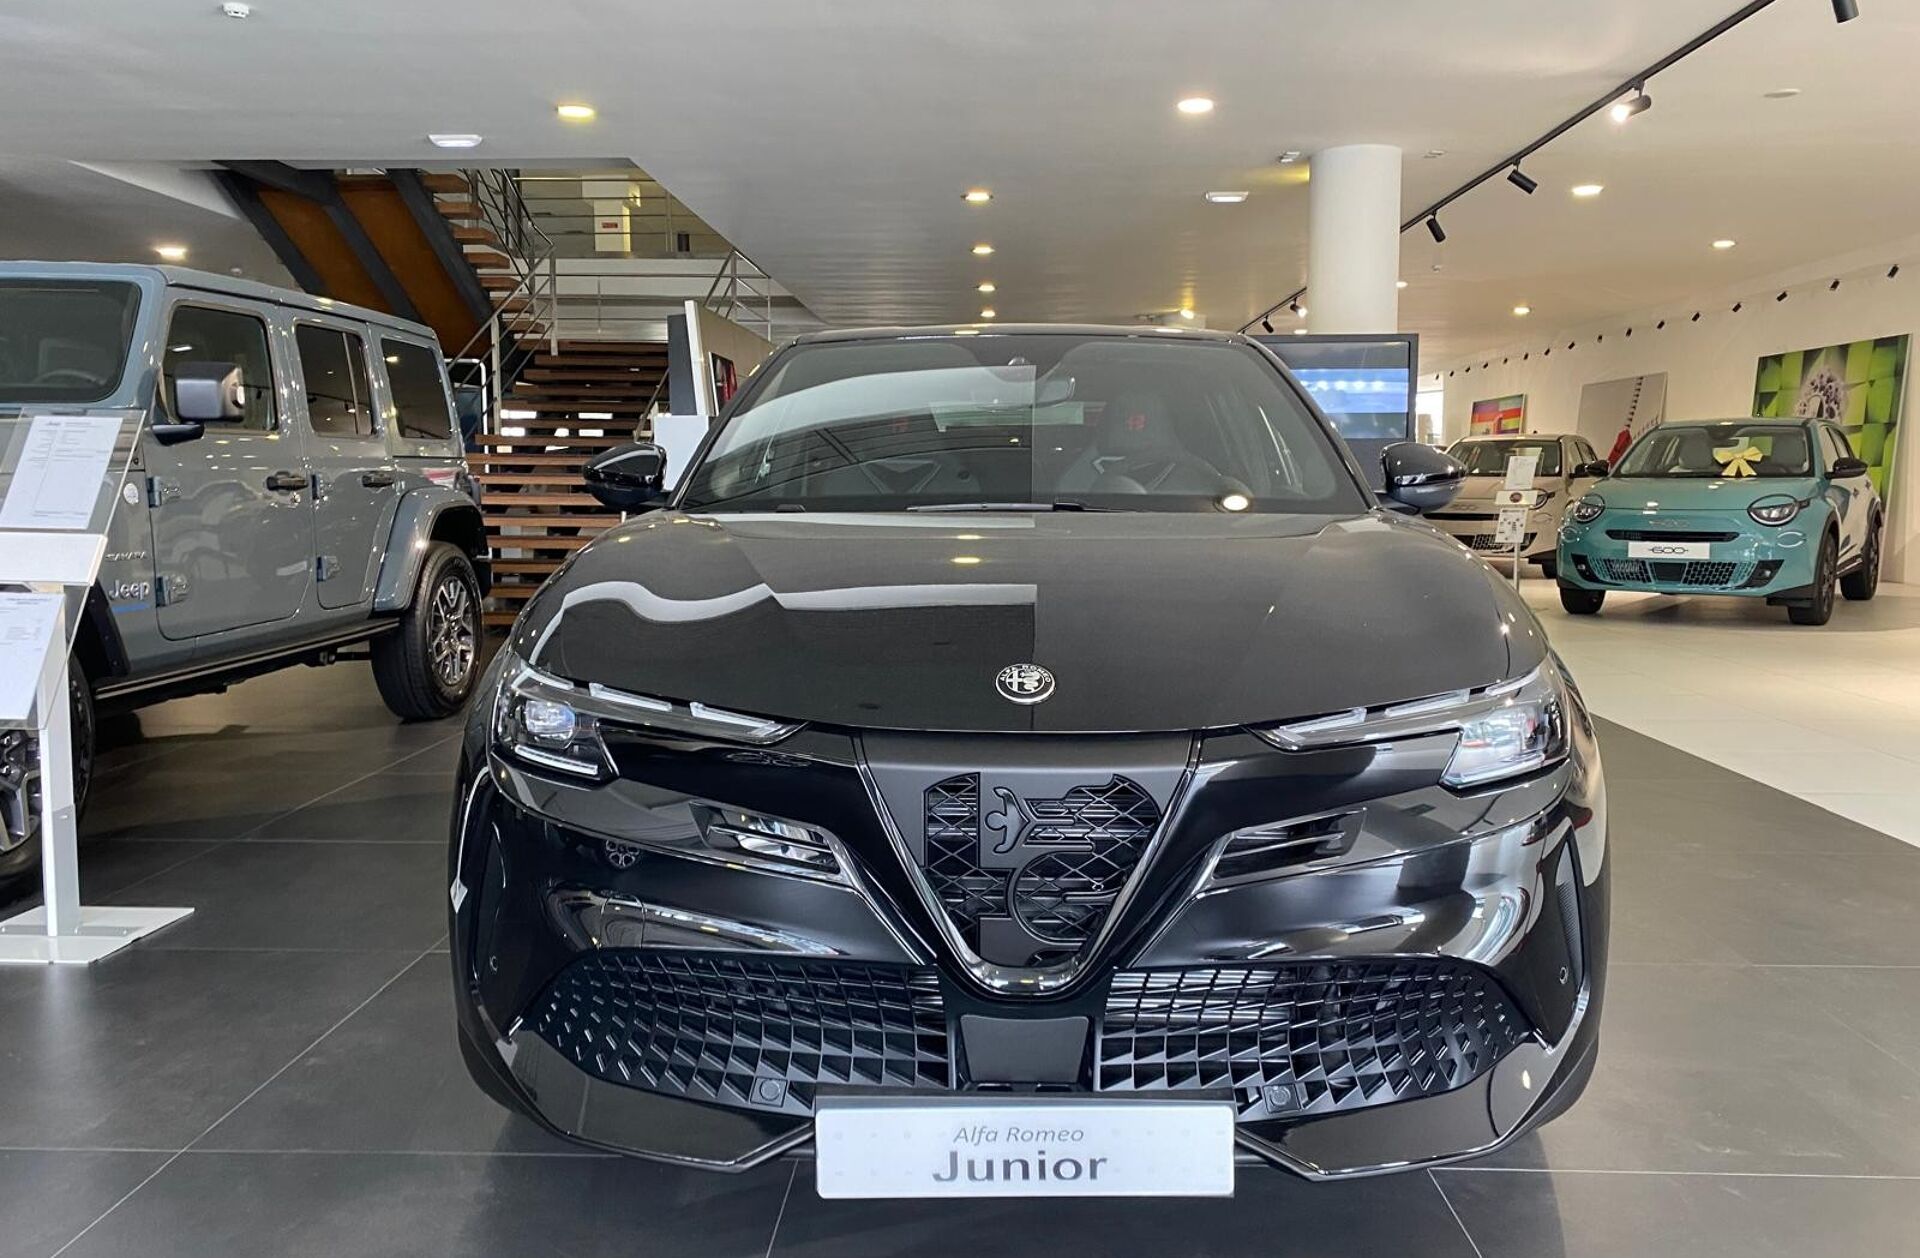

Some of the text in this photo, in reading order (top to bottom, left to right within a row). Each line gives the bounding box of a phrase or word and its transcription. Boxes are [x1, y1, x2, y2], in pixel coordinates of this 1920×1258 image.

[1650, 546, 1688, 554] 600
[109, 580, 150, 600] Jeep
[1022, 665, 1051, 682] ROMEO
[953, 1126, 1084, 1146] Alfa Romeo
[933, 1150, 1107, 1182] Junior
